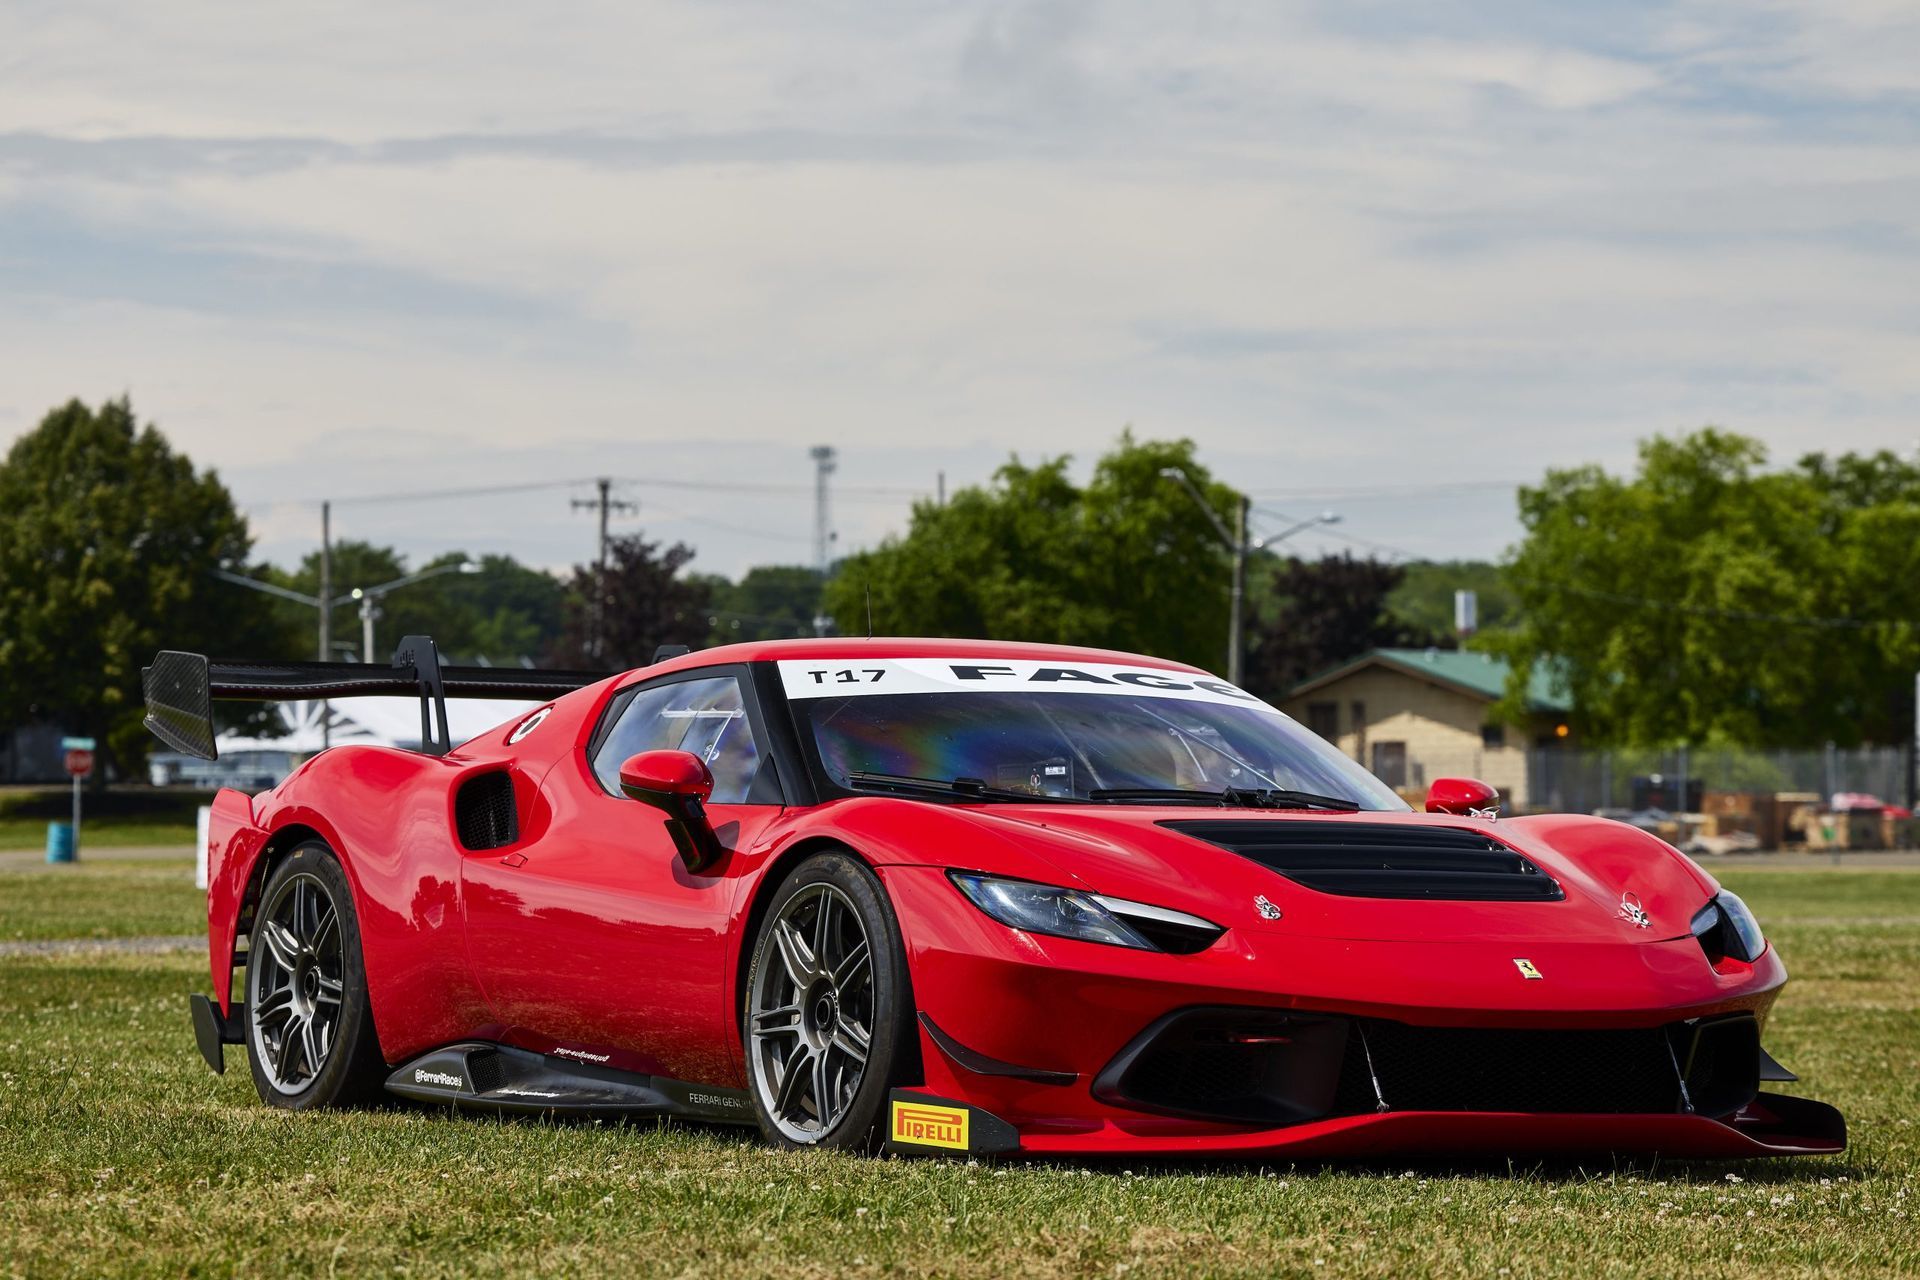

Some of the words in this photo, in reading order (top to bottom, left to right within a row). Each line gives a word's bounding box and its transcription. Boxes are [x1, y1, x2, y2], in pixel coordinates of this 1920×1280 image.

[808, 669, 886, 684] T17
[689, 1092, 722, 1106] FERRARI
[897, 1107, 963, 1143] PIRELLI
